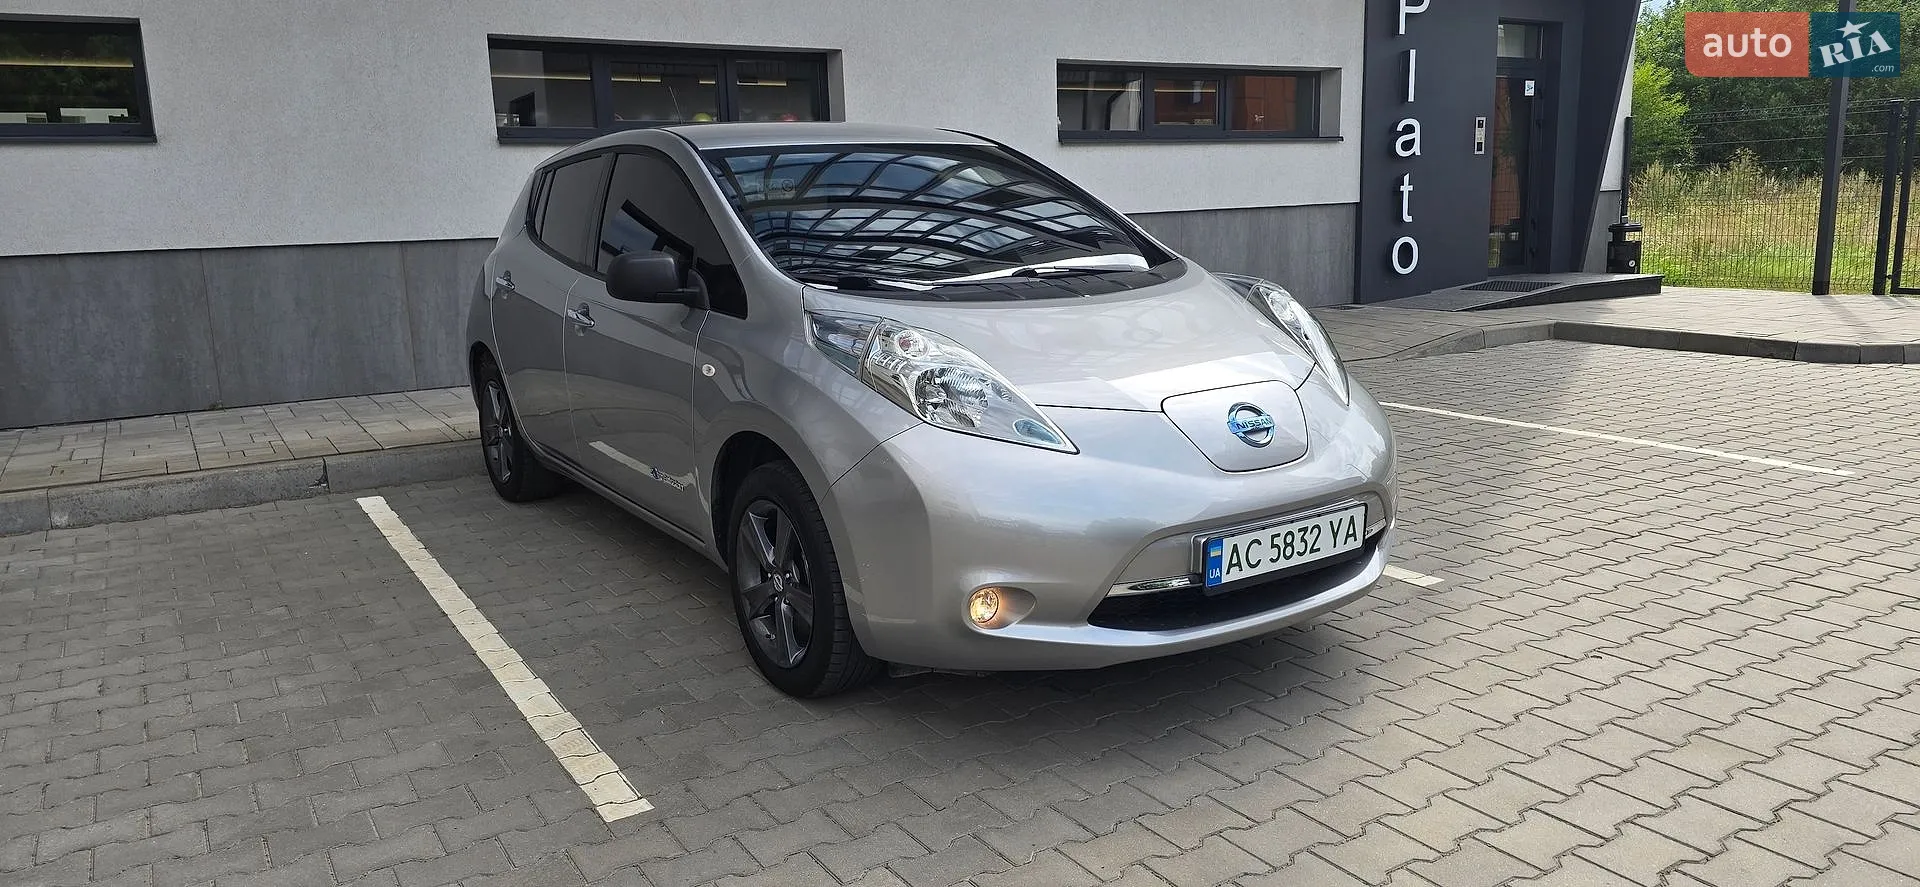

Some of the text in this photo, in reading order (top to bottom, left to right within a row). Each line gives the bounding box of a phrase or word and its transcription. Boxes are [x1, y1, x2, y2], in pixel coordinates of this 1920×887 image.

[1392, 0, 1430, 275] Plato
[1236, 418, 1272, 430] NISSAN
[1225, 515, 1358, 575] AC 5832 YA
[1209, 568, 1221, 579] UA
